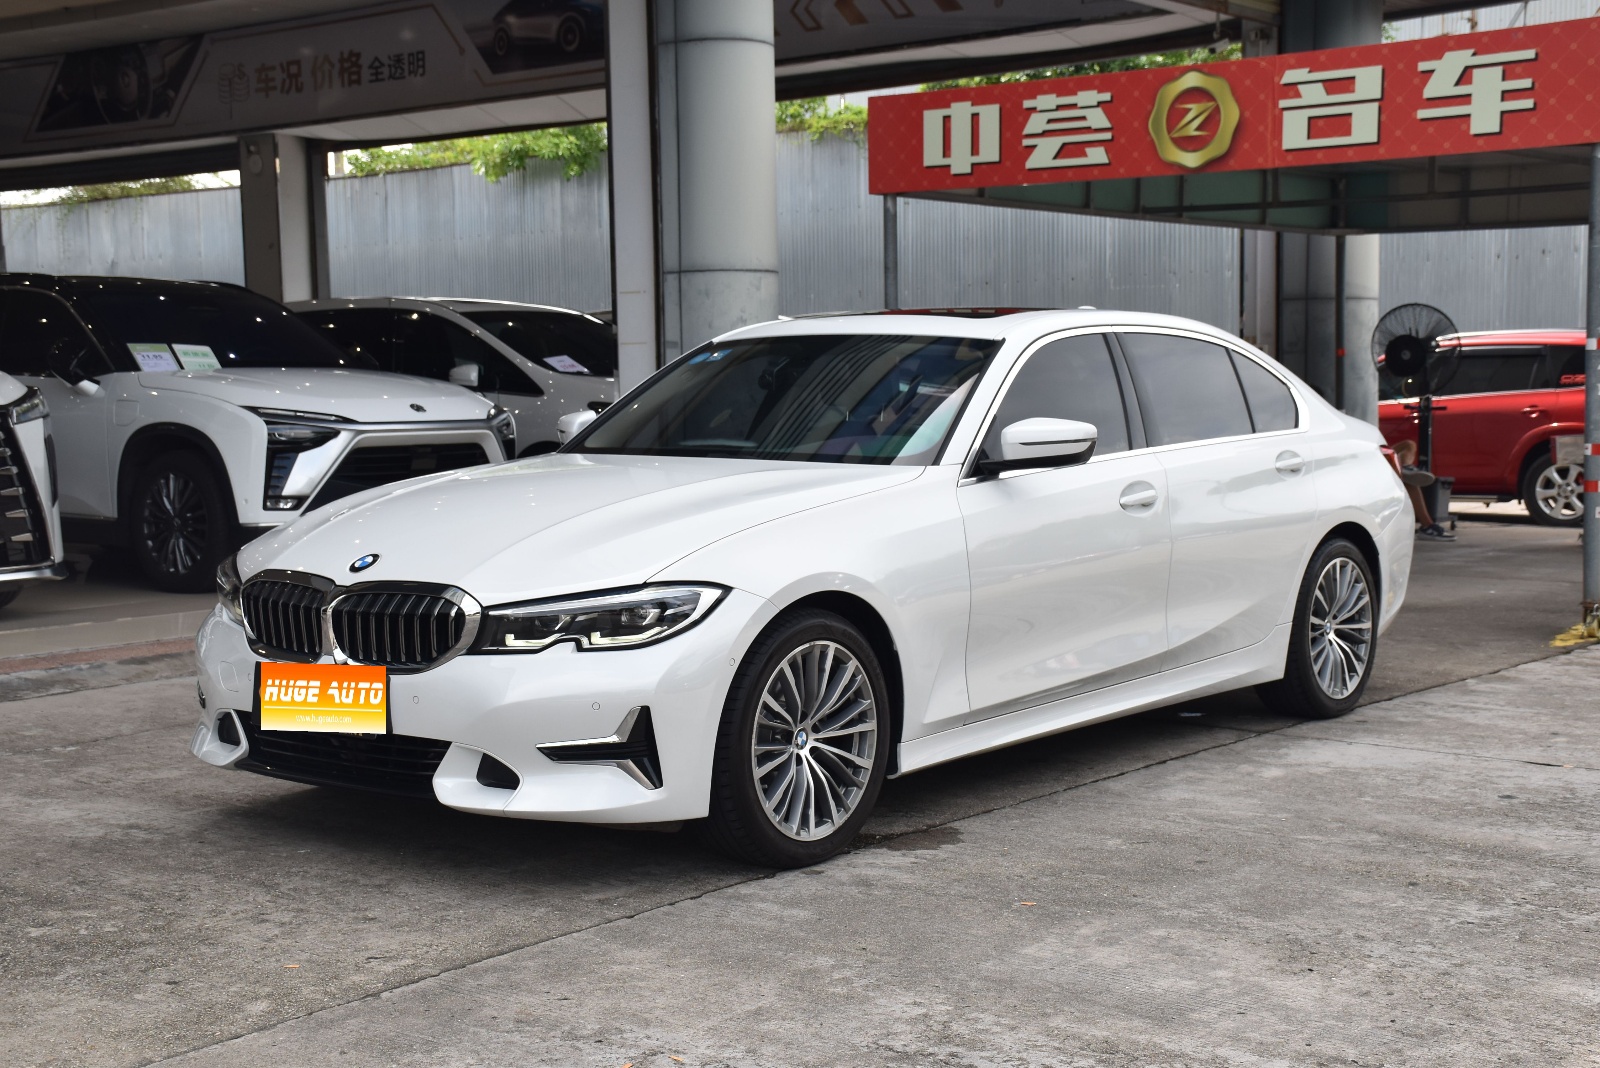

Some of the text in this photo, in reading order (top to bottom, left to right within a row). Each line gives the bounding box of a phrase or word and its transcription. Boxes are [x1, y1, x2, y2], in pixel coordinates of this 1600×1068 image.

[254, 49, 426, 98] 车况 价格 全透明
[923, 49, 1537, 175] 中荟 名车
